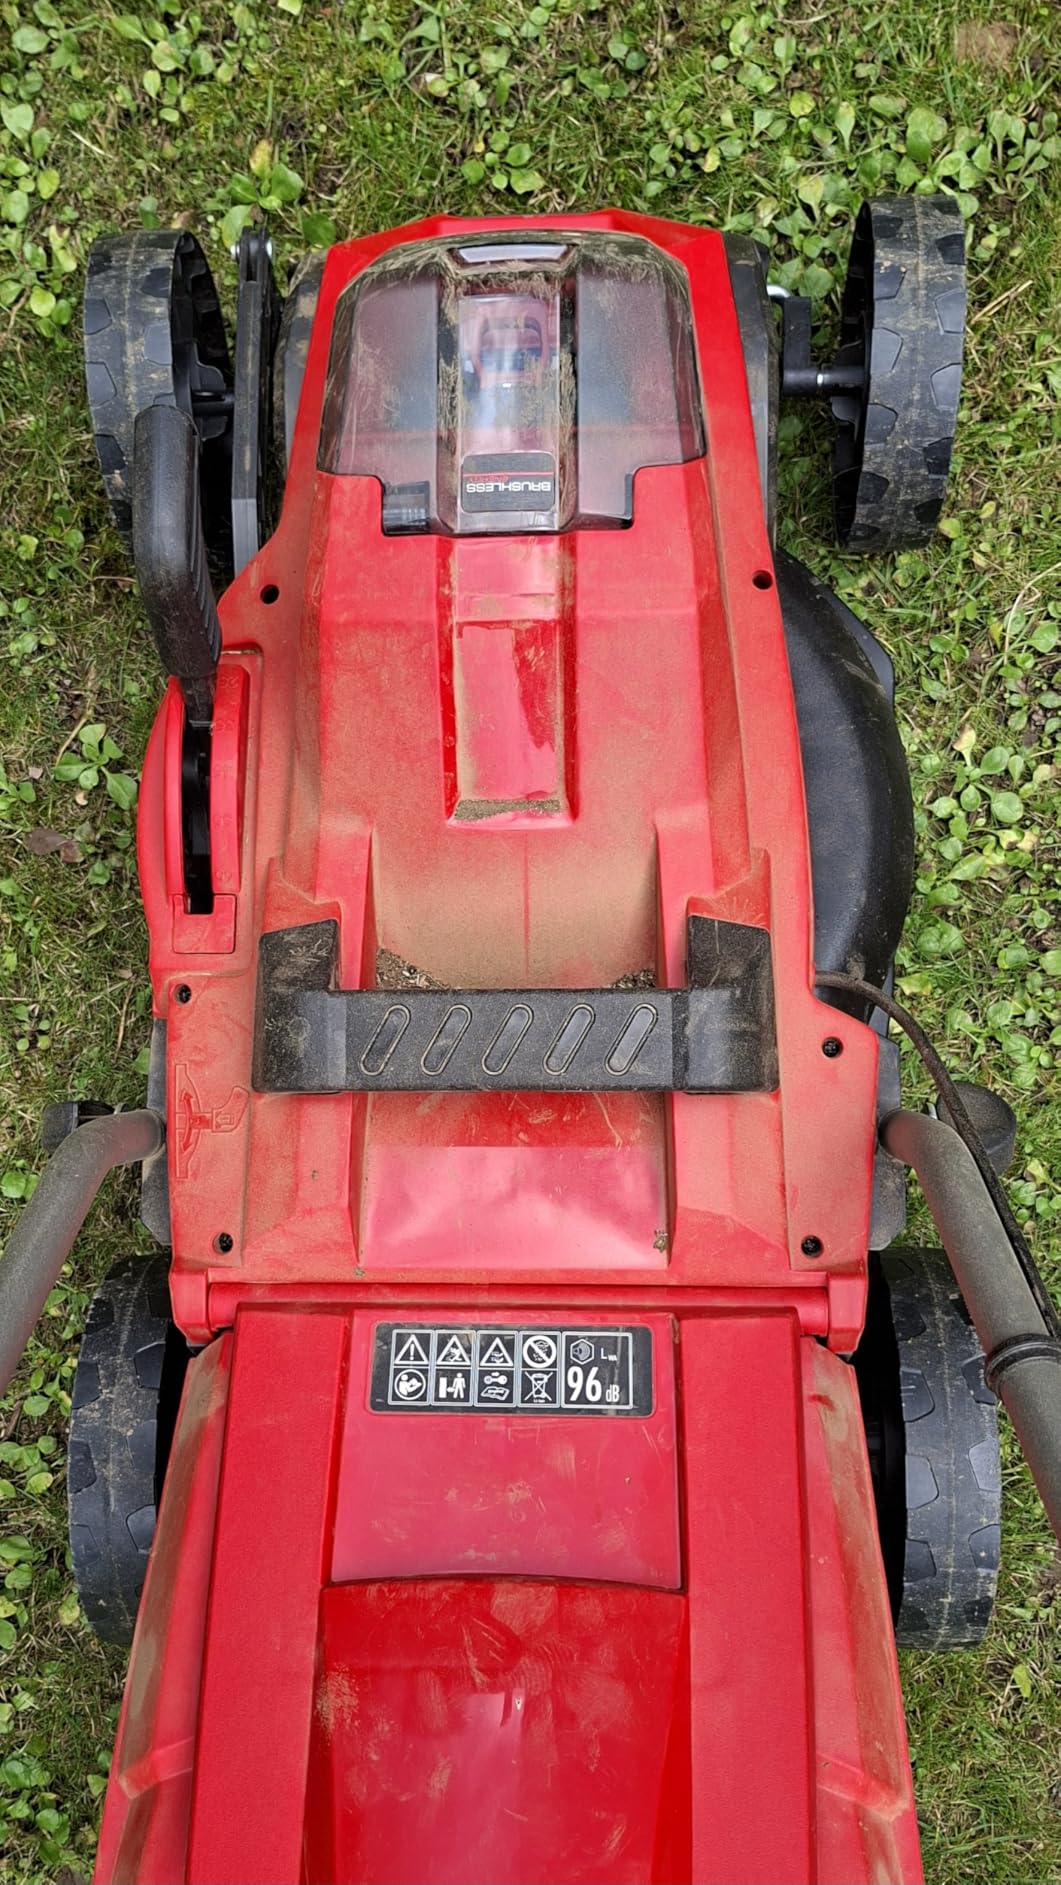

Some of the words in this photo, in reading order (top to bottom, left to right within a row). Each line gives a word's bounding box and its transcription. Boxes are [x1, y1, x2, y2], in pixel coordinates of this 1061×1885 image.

[466, 481, 551, 493] BRUSHLESS
[567, 1366, 602, 1402] 96
[605, 1384, 620, 1403] dB
